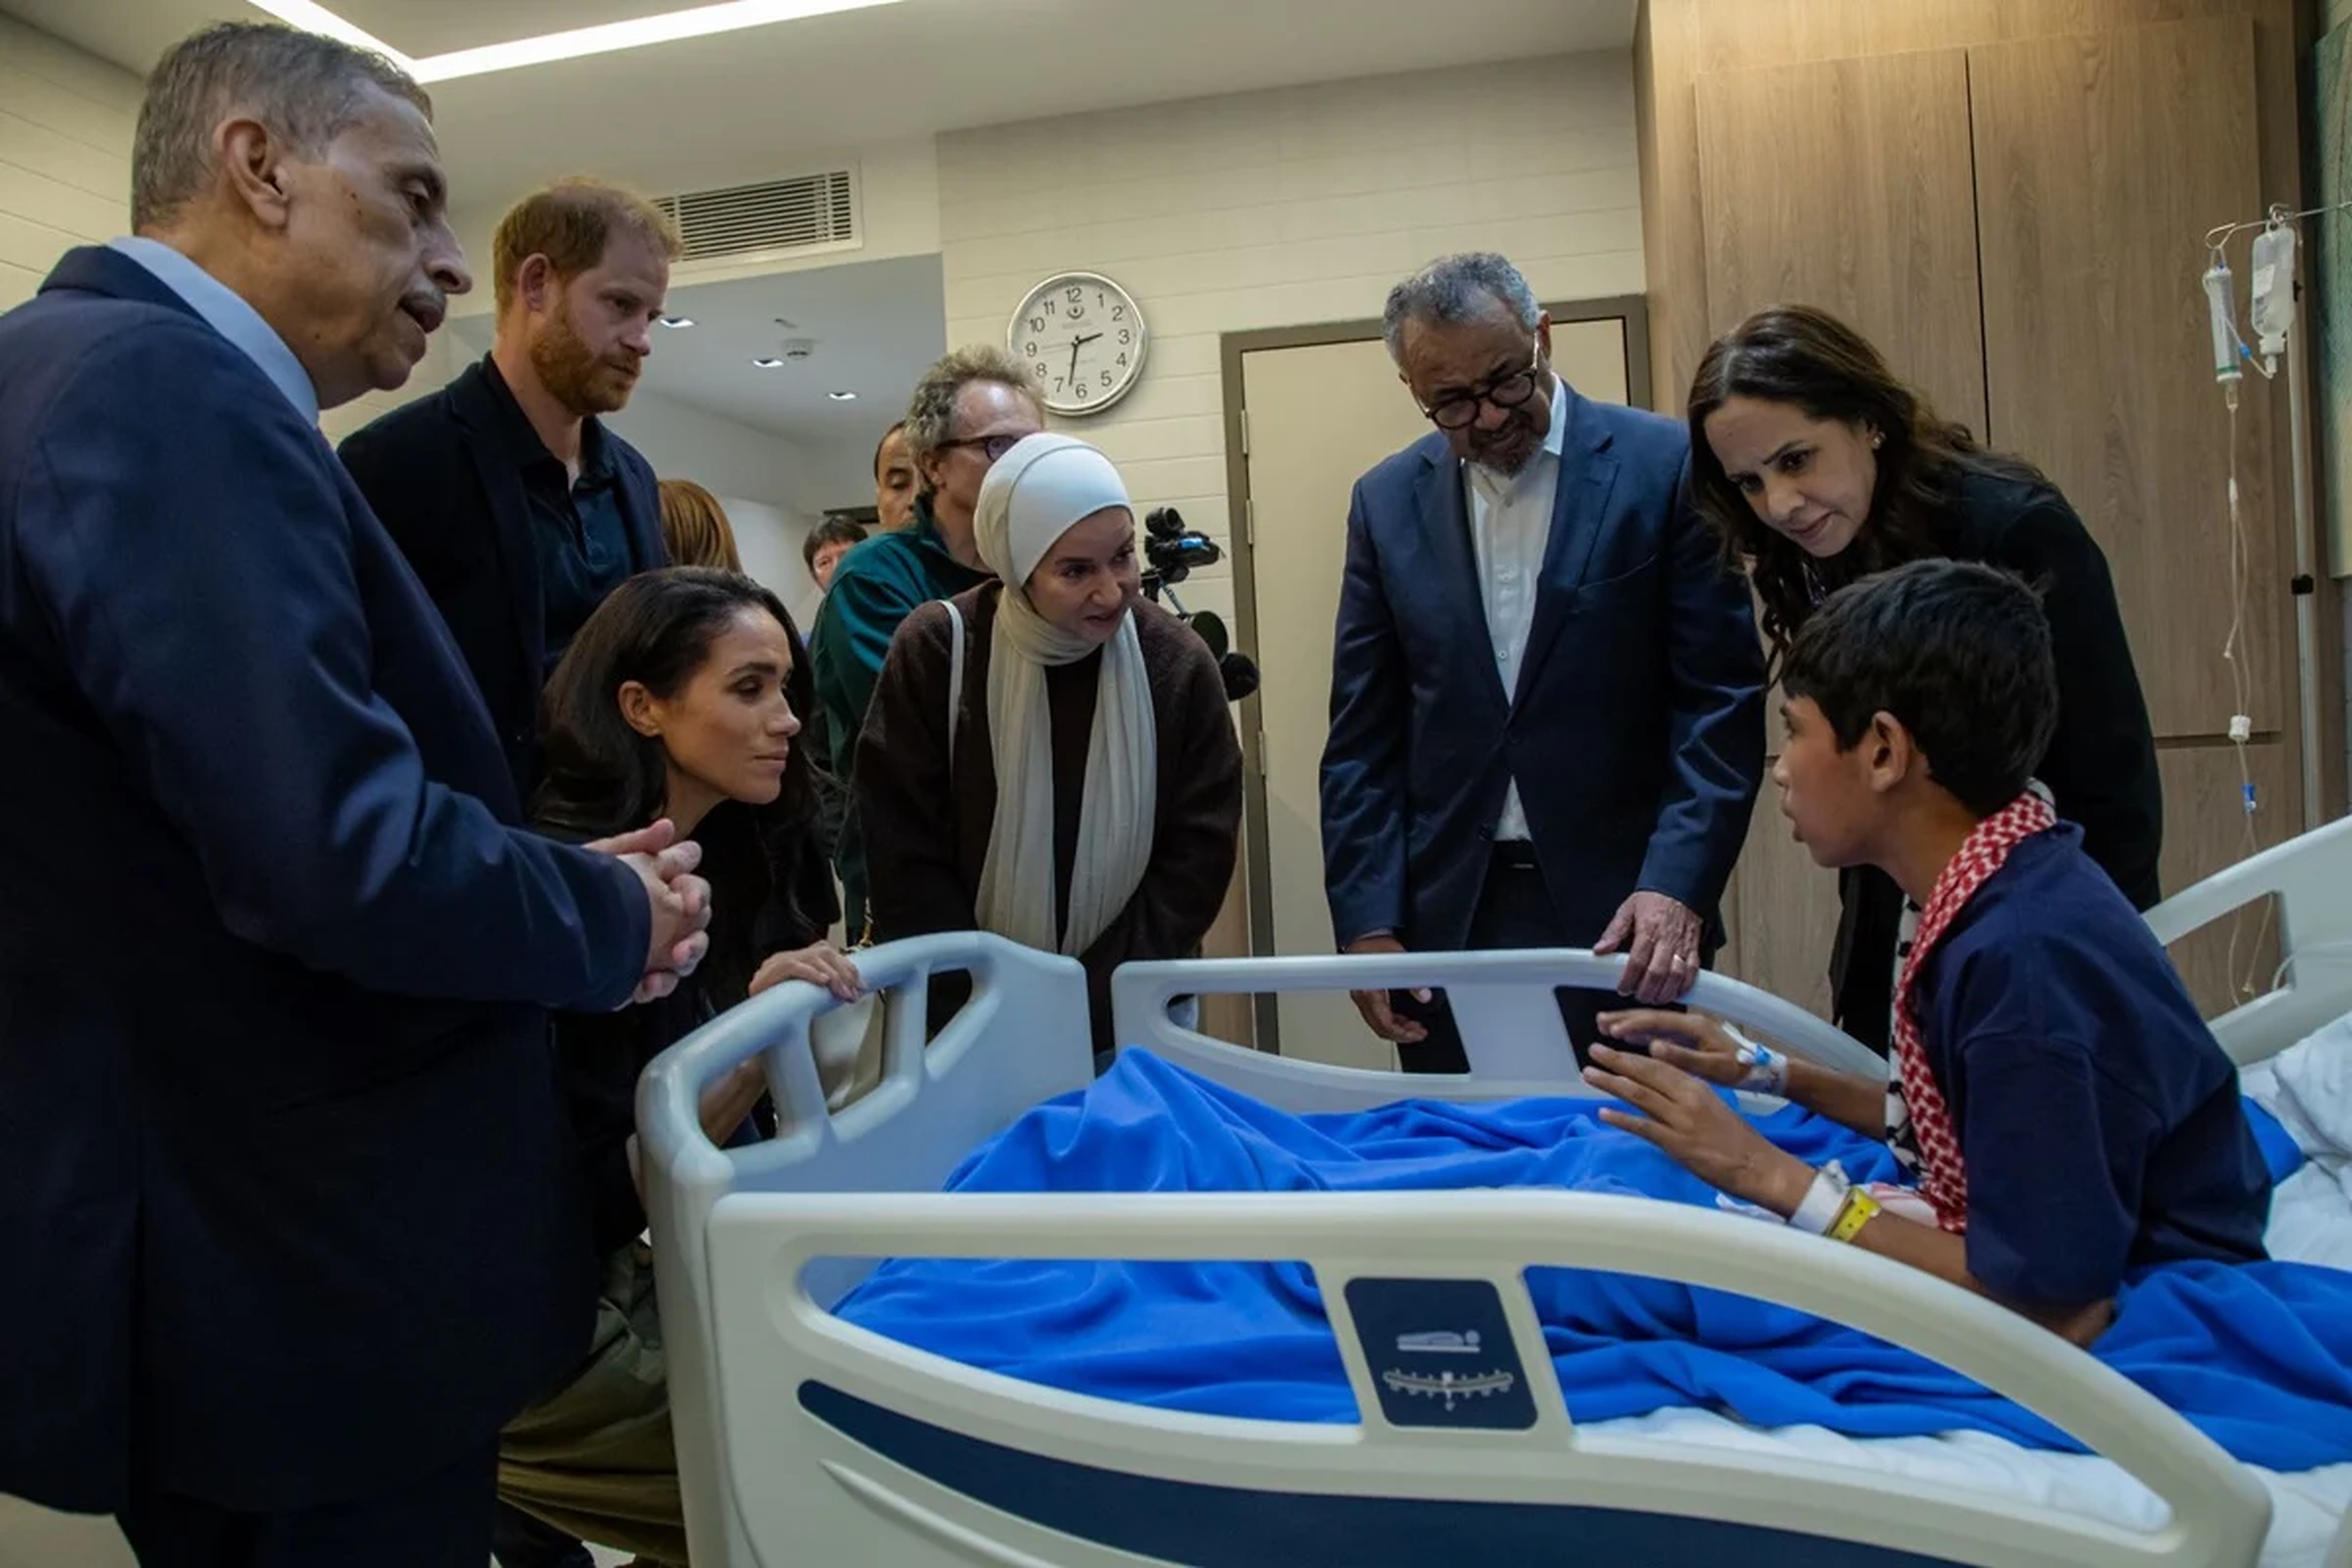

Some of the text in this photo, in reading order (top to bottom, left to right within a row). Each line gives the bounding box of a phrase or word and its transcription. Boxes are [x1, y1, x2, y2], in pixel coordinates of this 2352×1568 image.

[1066, 287, 1082, 303] 12
[1097, 293, 1104, 307] 1
[1044, 301, 1055, 315] 11
[1112, 306, 1123, 321] 2
[1030, 317, 1045, 333] 10
[1118, 329, 1129, 344] 3
[1025, 342, 1037, 357] 9
[1116, 352, 1126, 367] 4
[1036, 362, 1047, 377] 8
[1054, 377, 1064, 393] 7
[1101, 370, 1112, 386] 5
[1076, 383, 1087, 398] 6
